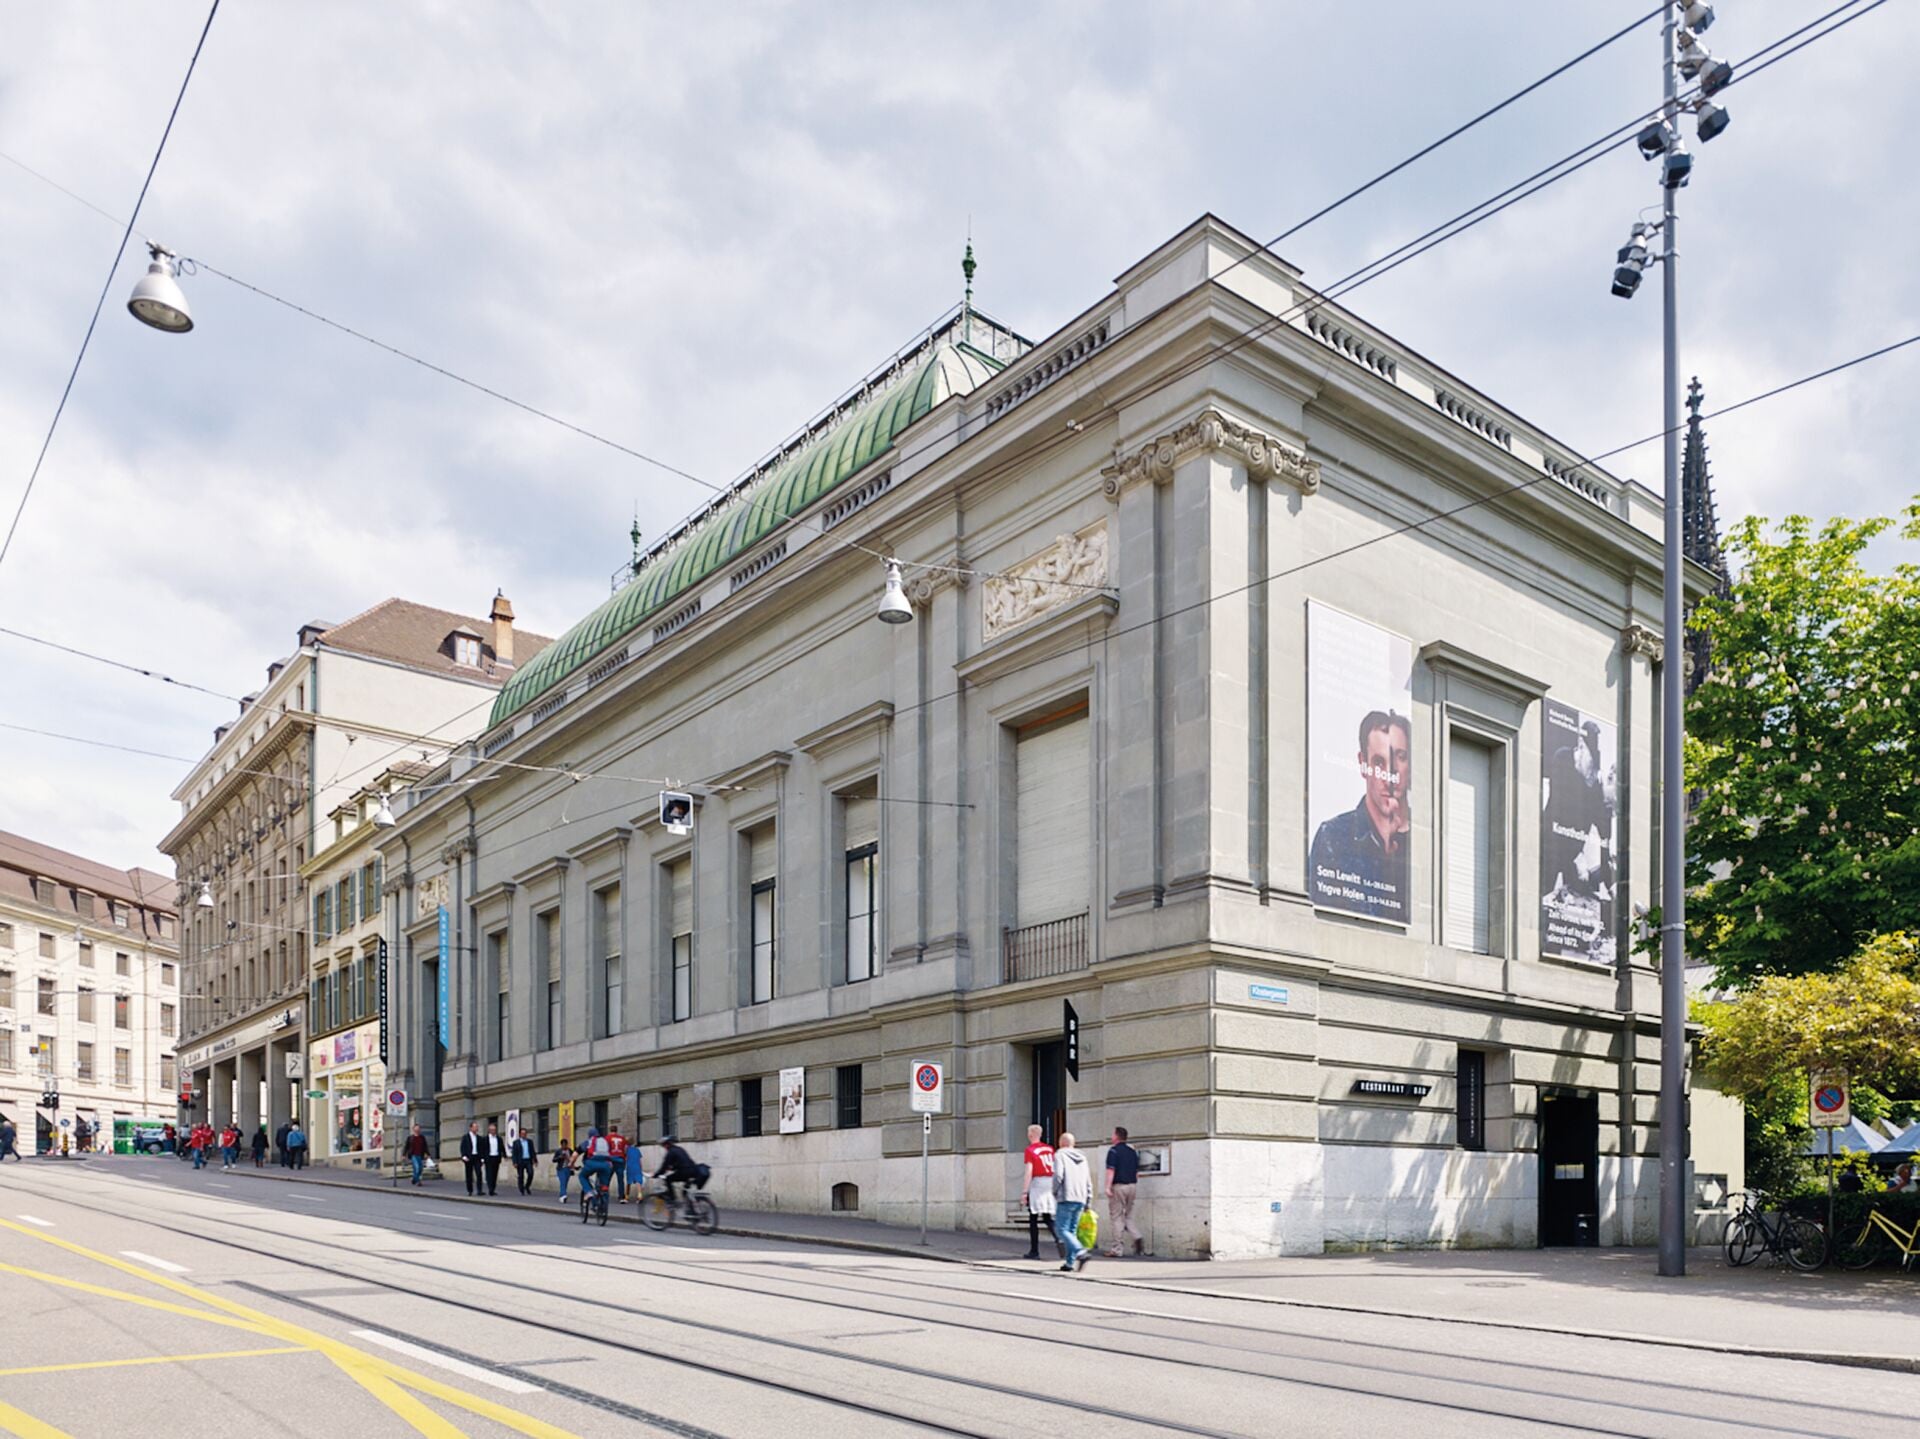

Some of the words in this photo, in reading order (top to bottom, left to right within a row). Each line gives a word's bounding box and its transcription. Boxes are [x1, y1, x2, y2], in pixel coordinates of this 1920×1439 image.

[1374, 766, 1400, 784] Basel
[1316, 865, 1336, 880] Sam
[1336, 869, 1361, 885] Lewitt
[1316, 880, 1341, 896] Yngve
[1342, 886, 1366, 901] Holen
[1360, 1082, 1404, 1094] RESTAURANT
